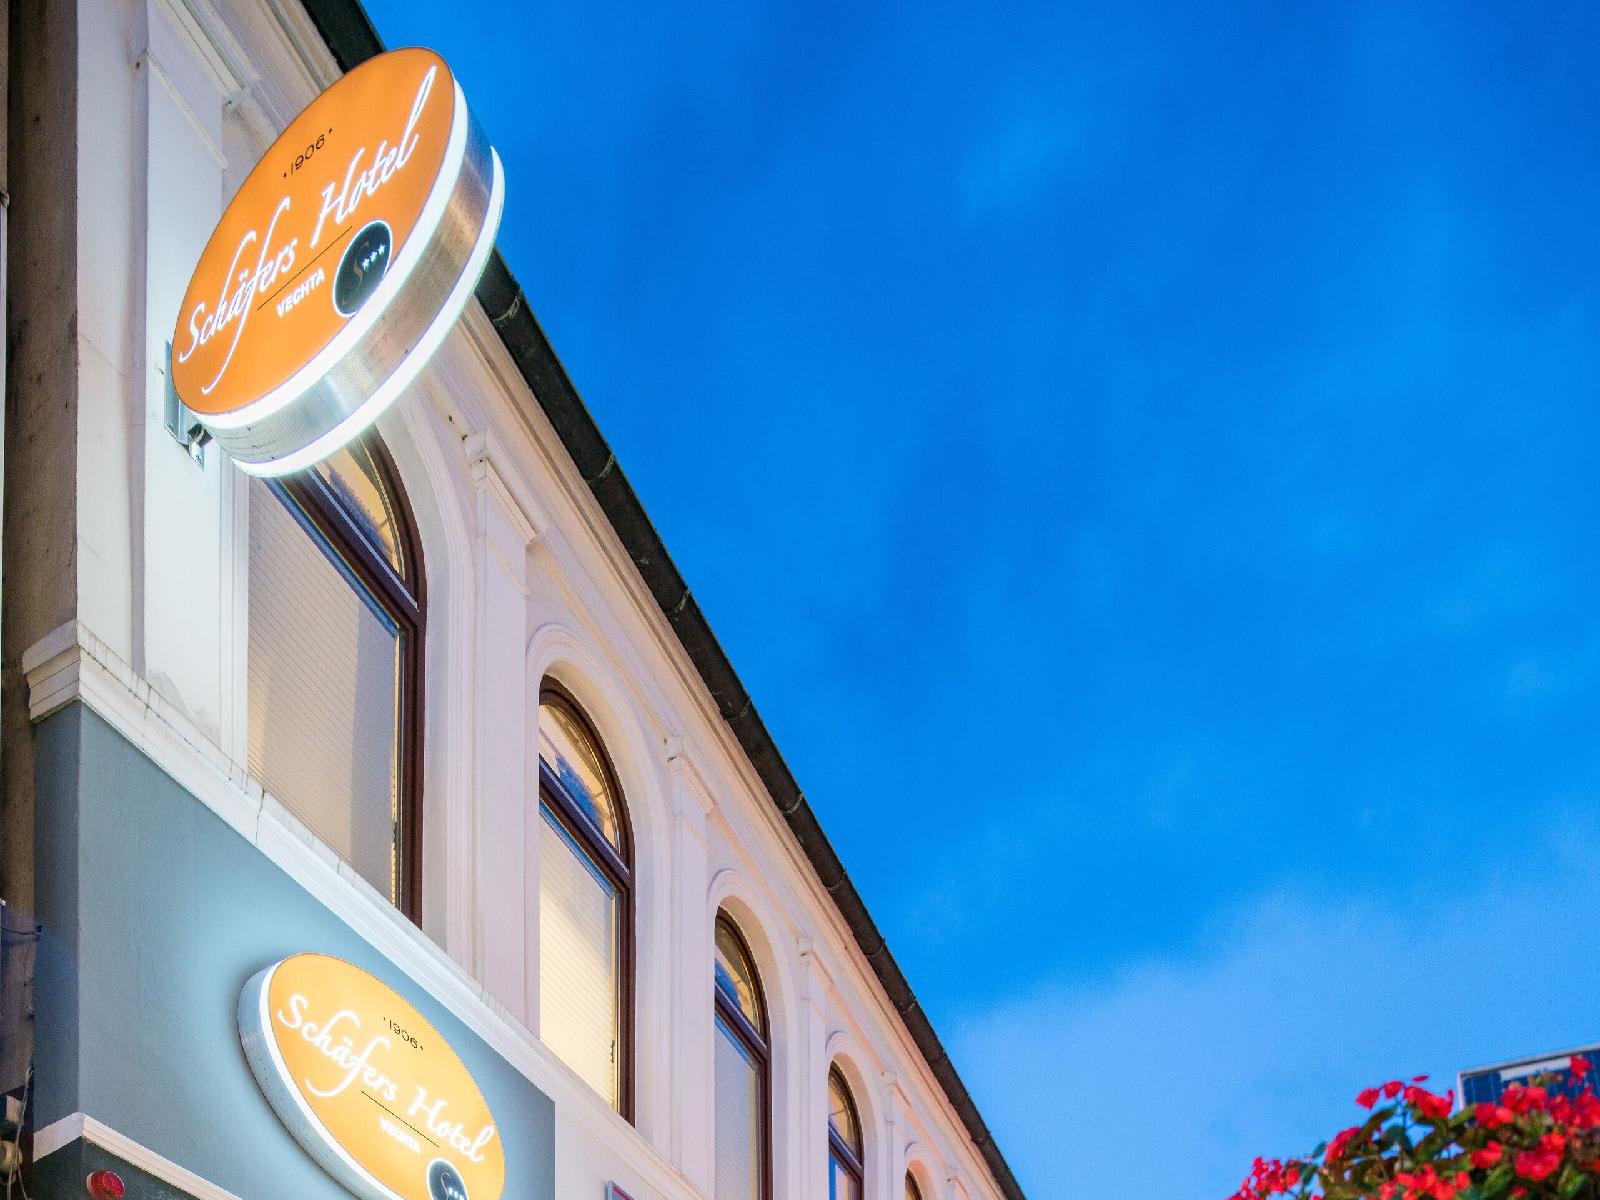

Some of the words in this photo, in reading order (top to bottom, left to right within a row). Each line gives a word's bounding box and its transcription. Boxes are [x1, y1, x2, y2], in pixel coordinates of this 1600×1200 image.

[178, 196, 298, 396] Schäfers
[310, 65, 438, 249] Hotel
[275, 267, 326, 319] VECHTA
[278, 992, 399, 1102] Schäfers
[406, 1085, 495, 1163] Hotel
